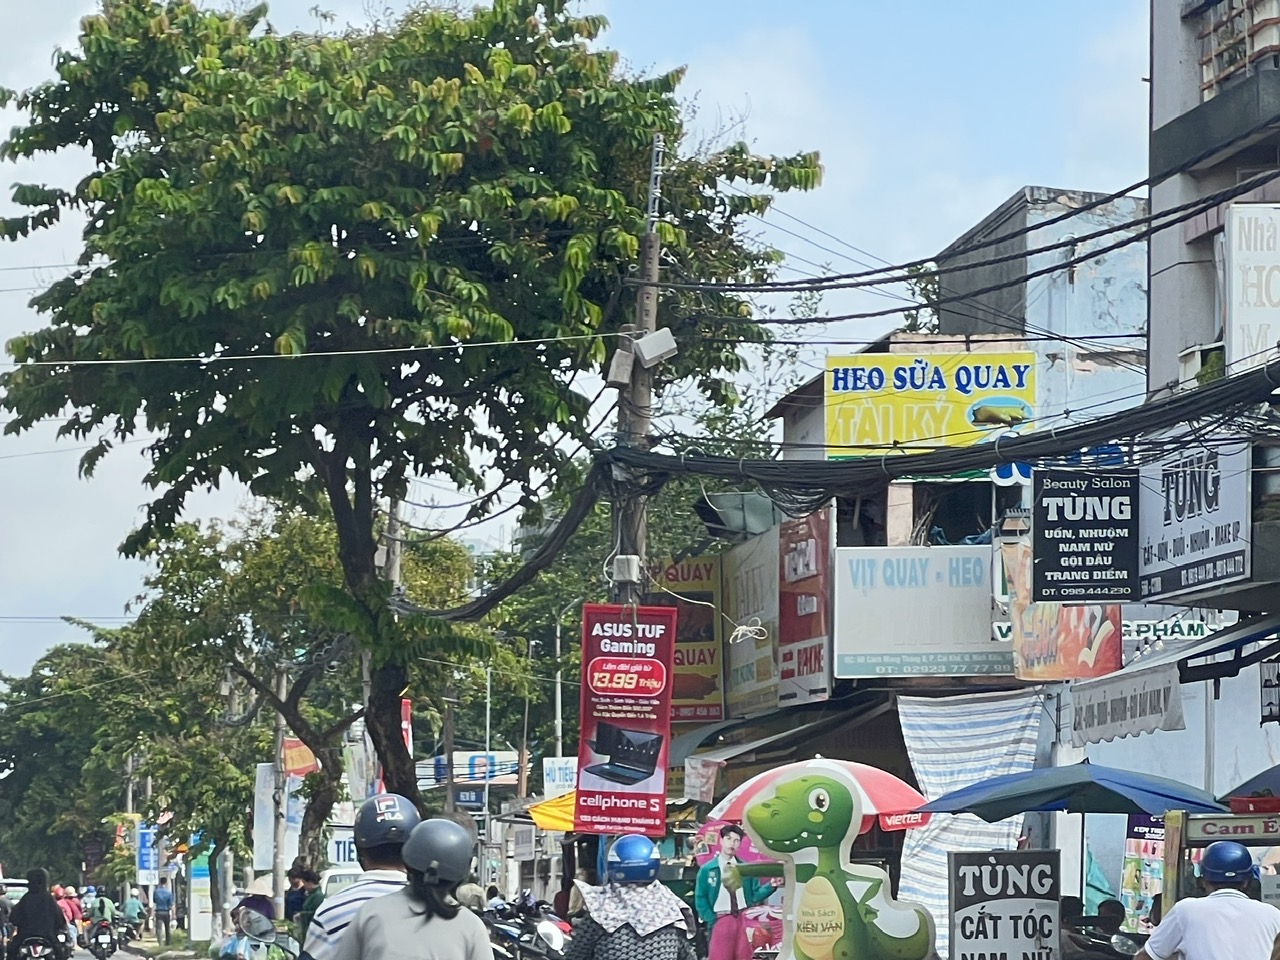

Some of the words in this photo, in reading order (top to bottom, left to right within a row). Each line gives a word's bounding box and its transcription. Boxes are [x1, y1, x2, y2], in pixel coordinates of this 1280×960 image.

[832, 367, 885, 391] HEO
[893, 359, 947, 390] SỮA
[955, 364, 1031, 395] QUAY
[1043, 478, 1088, 490] Beauty
[1092, 478, 1131, 488] Salon
[1042, 492, 1131, 520] TÙNG
[1059, 543, 1091, 552] NAM
[664, 563, 713, 582] QUAY
[849, 558, 877, 596] VỊT
[882, 557, 930, 587] QUAY
[949, 556, 984, 588] HEO
[1045, 572, 1089, 580] TRANG
[592, 623, 632, 637] ASUS
[636, 624, 666, 638] TUF
[600, 638, 656, 657] Gaming
[674, 648, 716, 666] QUAY
[903, 665, 946, 673] 02923
[592, 672, 638, 689] 13.99
[580, 795, 647, 810] cellphone
[650, 799, 660, 811] S
[376, 812, 404, 822] FILA
[885, 813, 923, 826] viettel
[1201, 822, 1255, 835] Cam
[958, 856, 1054, 896] TÙNG
[961, 905, 1000, 940] CẮT
[1009, 908, 1053, 940] TÓC
